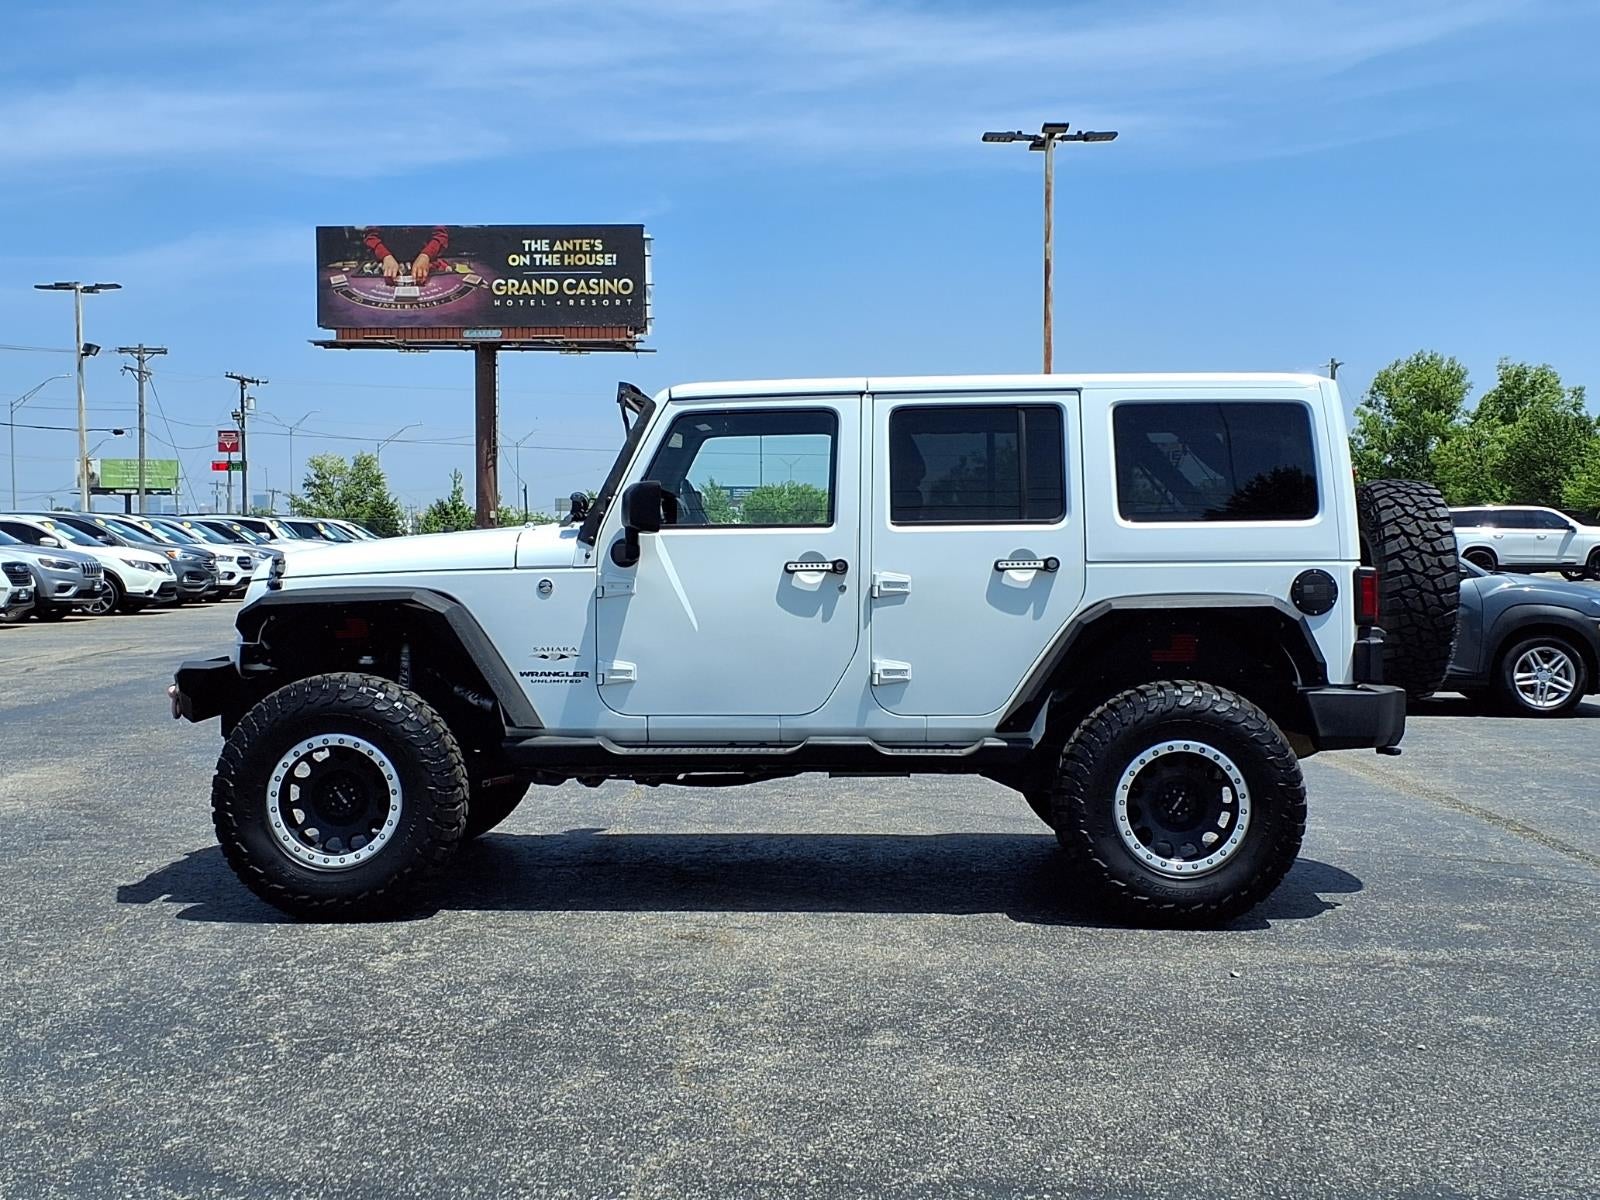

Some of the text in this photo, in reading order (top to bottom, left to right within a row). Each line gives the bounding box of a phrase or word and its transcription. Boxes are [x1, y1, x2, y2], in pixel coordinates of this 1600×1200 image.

[522, 239, 603, 252] THE ANTE'S
[508, 253, 617, 266] ON THE HOUSE!
[491, 278, 634, 295] GRAND CASINO
